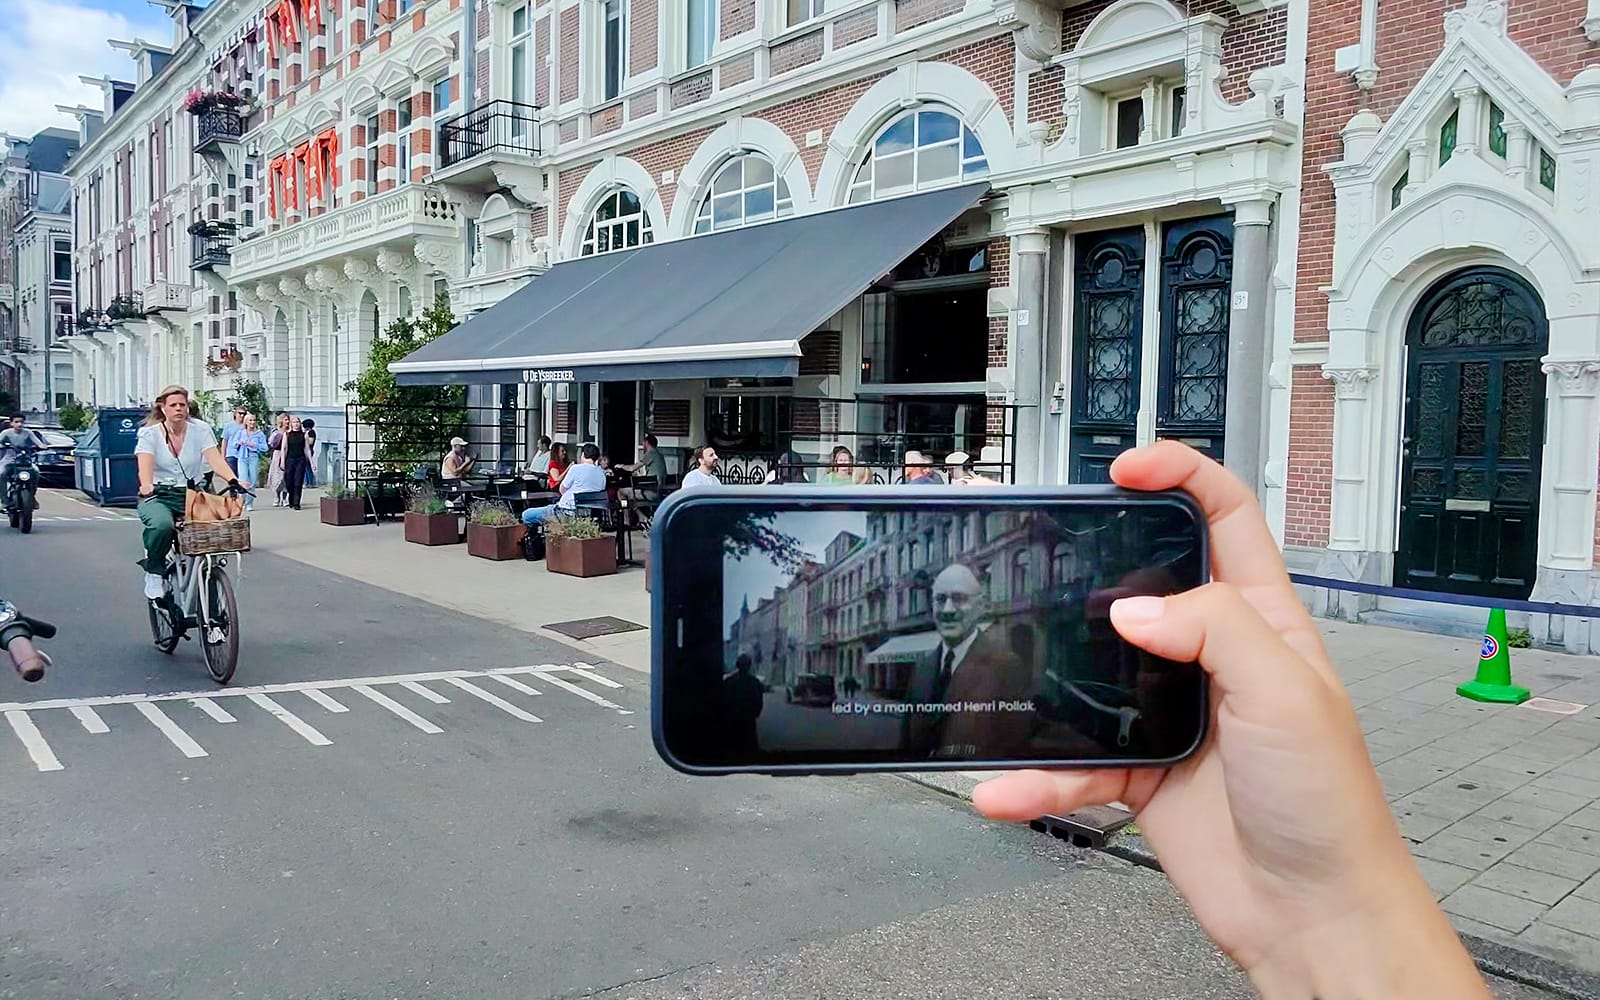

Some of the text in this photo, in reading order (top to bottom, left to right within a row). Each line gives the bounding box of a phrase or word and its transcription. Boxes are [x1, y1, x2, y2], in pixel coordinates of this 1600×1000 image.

[831, 702, 852, 713] led
[854, 702, 869, 716] by
[872, 703, 882, 713] a
[884, 703, 914, 713] man
[916, 701, 961, 713] named
[964, 700, 995, 712] Henri
